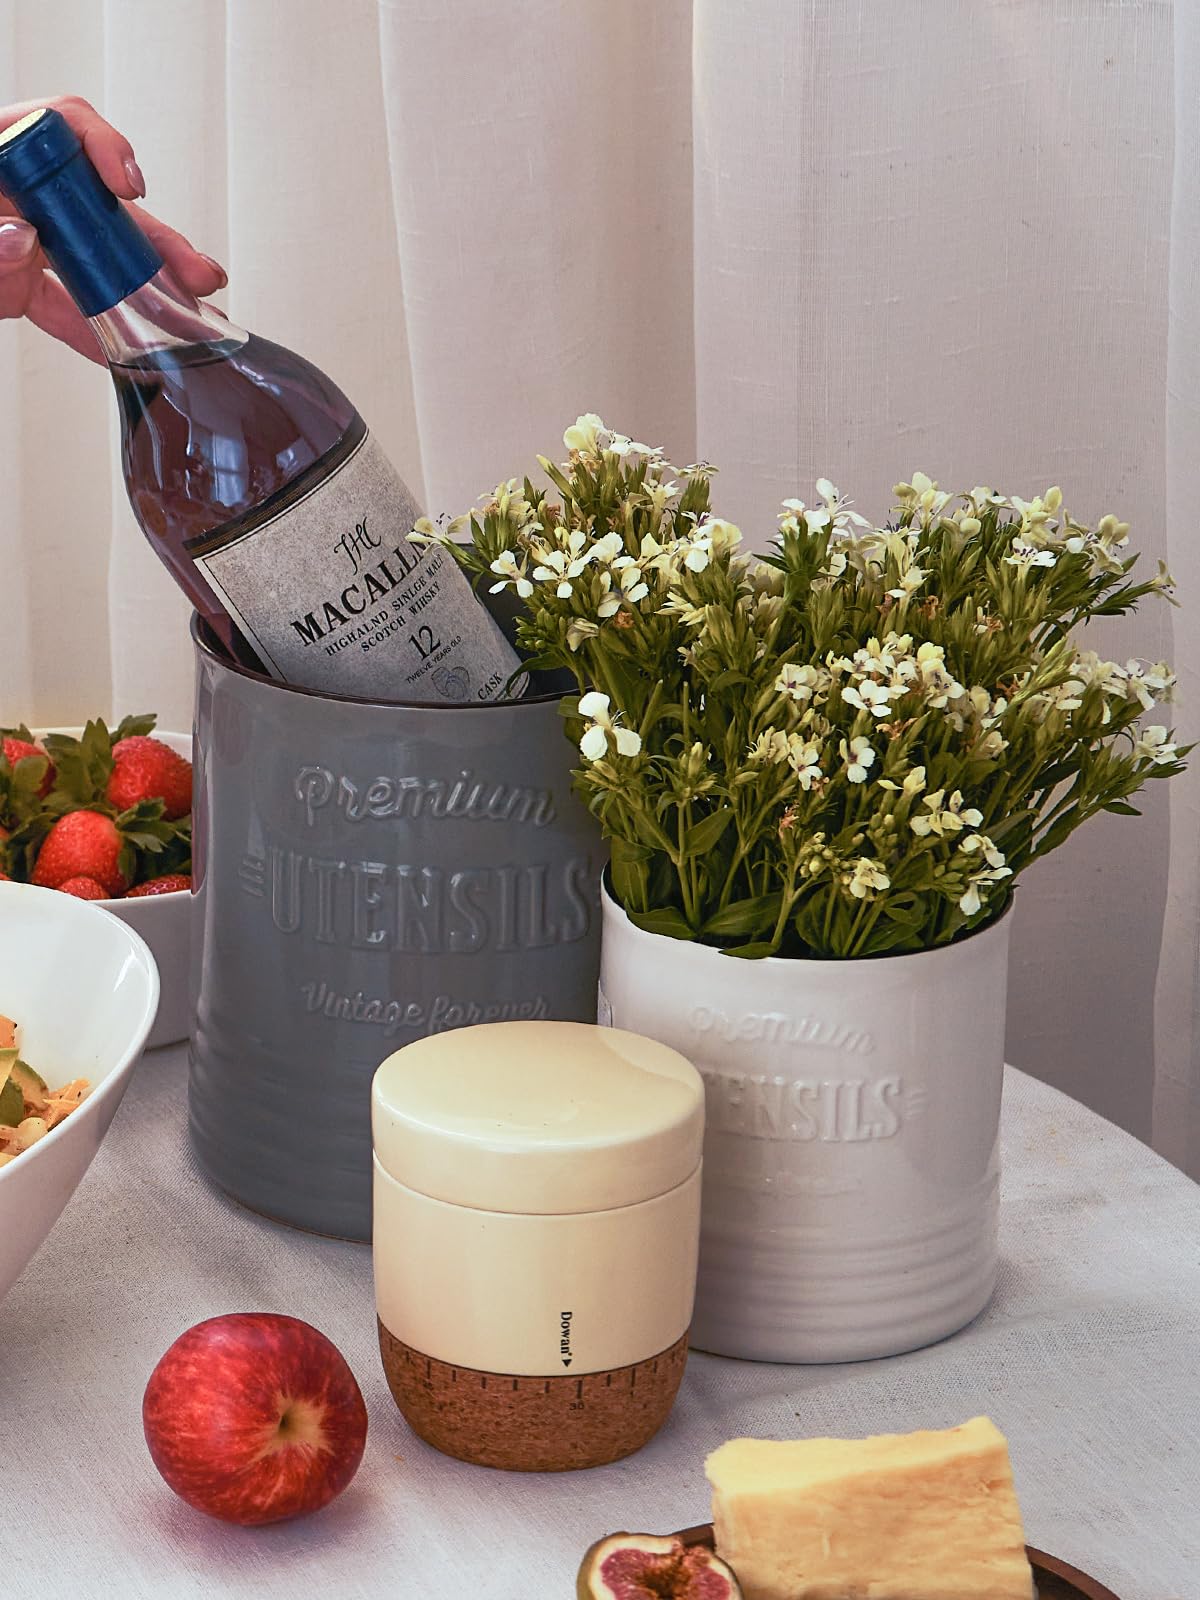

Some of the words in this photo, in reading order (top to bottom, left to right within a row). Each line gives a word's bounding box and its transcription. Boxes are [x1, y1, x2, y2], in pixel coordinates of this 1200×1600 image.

[361, 615, 406, 652] SCOTCH
[408, 625, 441, 661] 12
[406, 661, 433, 684] TWELVE
[432, 645, 453, 665] YEARS
[450, 635, 462, 648] OLD
[477, 671, 503, 700] CASK
[295, 766, 557, 827] Premium
[271, 851, 591, 953] UTENSILS
